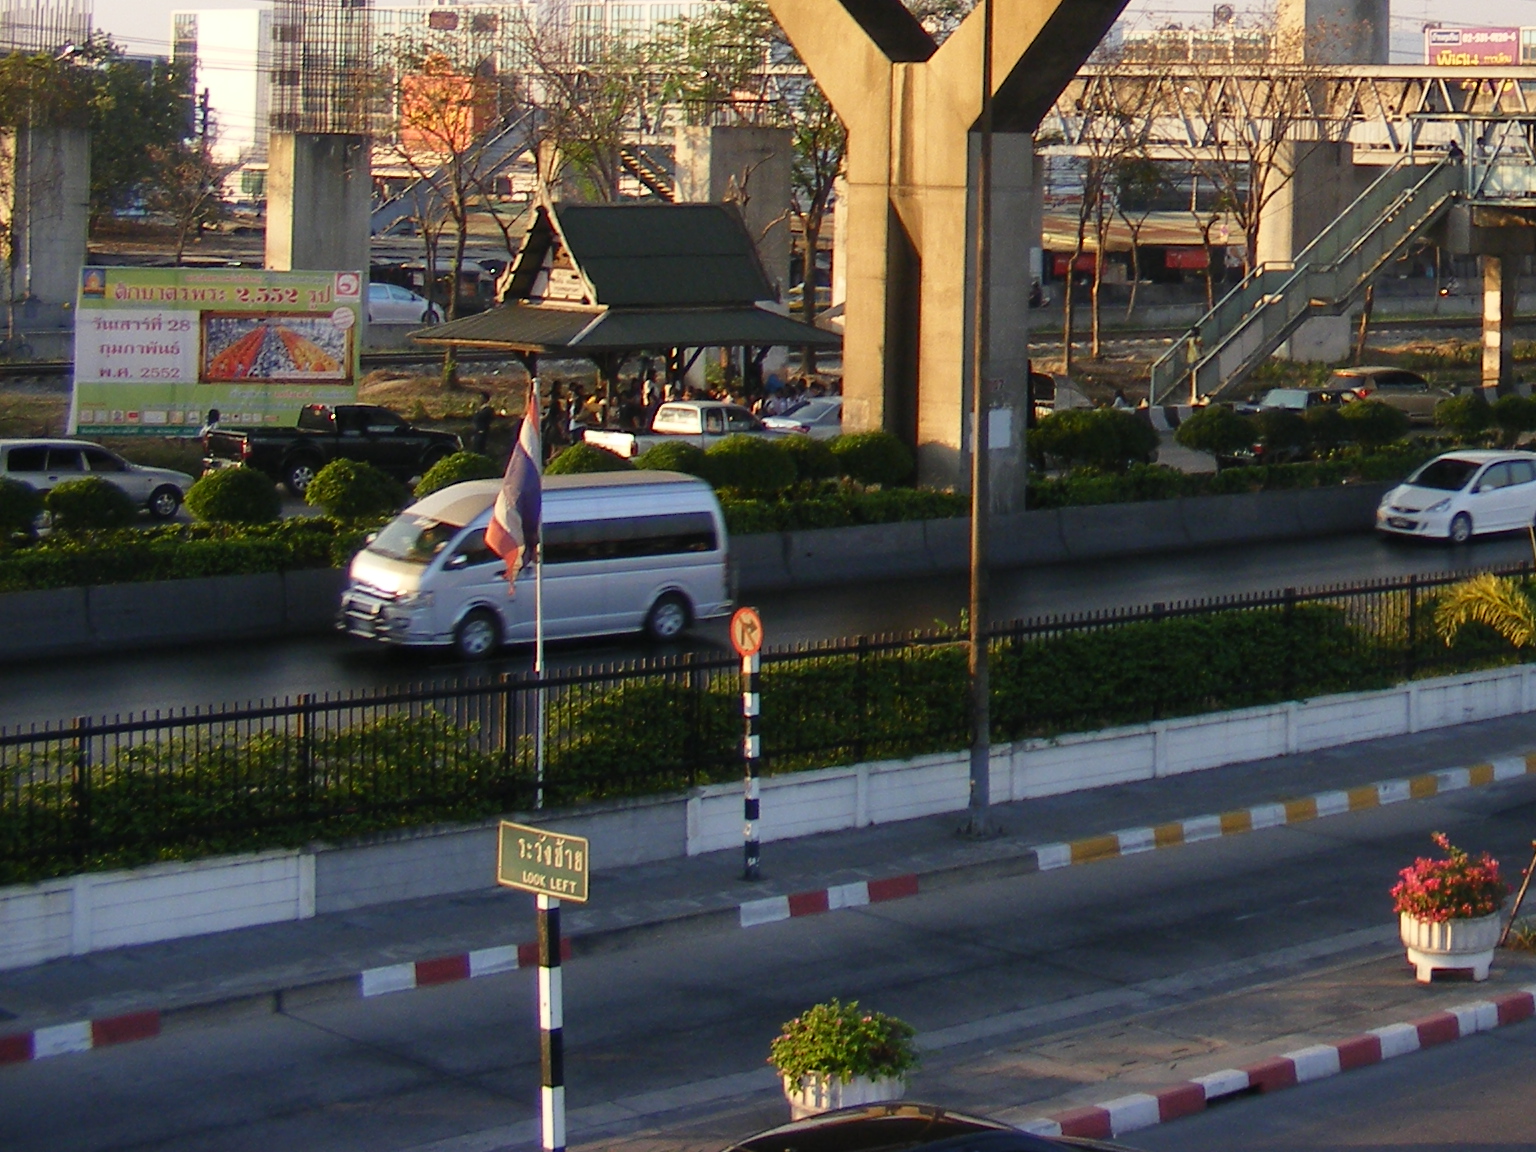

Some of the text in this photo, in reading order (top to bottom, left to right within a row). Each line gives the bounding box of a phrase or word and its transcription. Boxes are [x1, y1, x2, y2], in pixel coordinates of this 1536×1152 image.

[235, 287, 299, 306] 2,552
[92, 314, 191, 332] วันเสาร์ที่ 28
[99, 341, 181, 358] กุมภาพันธ์
[99, 367, 181, 379] พ.ศ. 2552
[518, 834, 583, 872] ระวังซ้าย
[522, 870, 577, 894] LOOK LEFT
